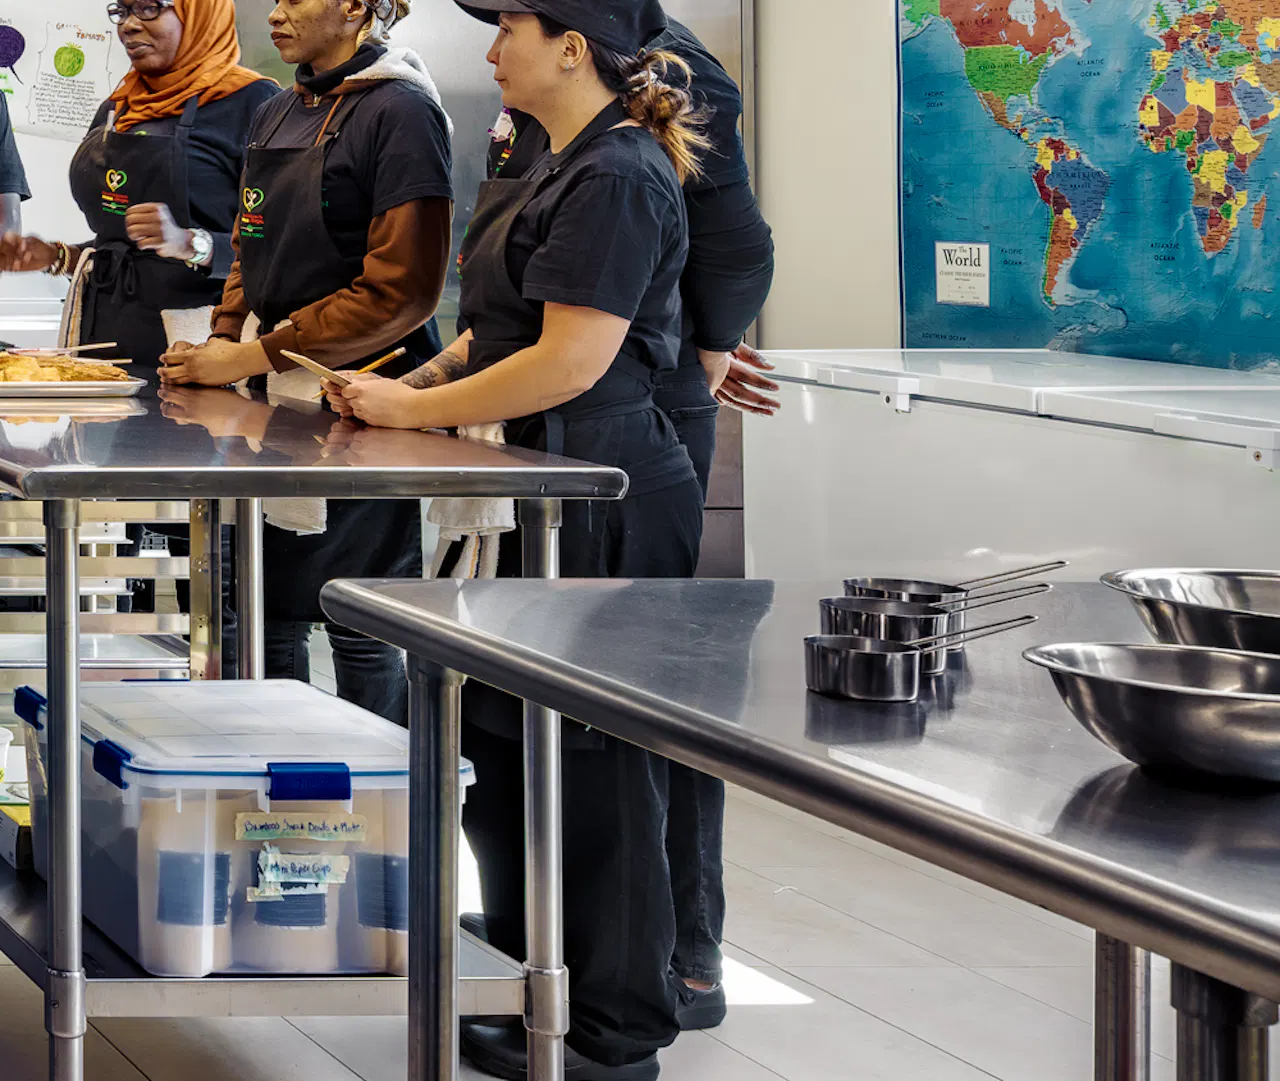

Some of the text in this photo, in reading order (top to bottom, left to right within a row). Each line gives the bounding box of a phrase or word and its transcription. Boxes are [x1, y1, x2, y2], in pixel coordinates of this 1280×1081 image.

[1077, 58, 1105, 66] ATLANTIC
[1080, 70, 1101, 78] OCEAN
[943, 247, 982, 267] World
[922, 332, 947, 340] SOUTHERN
